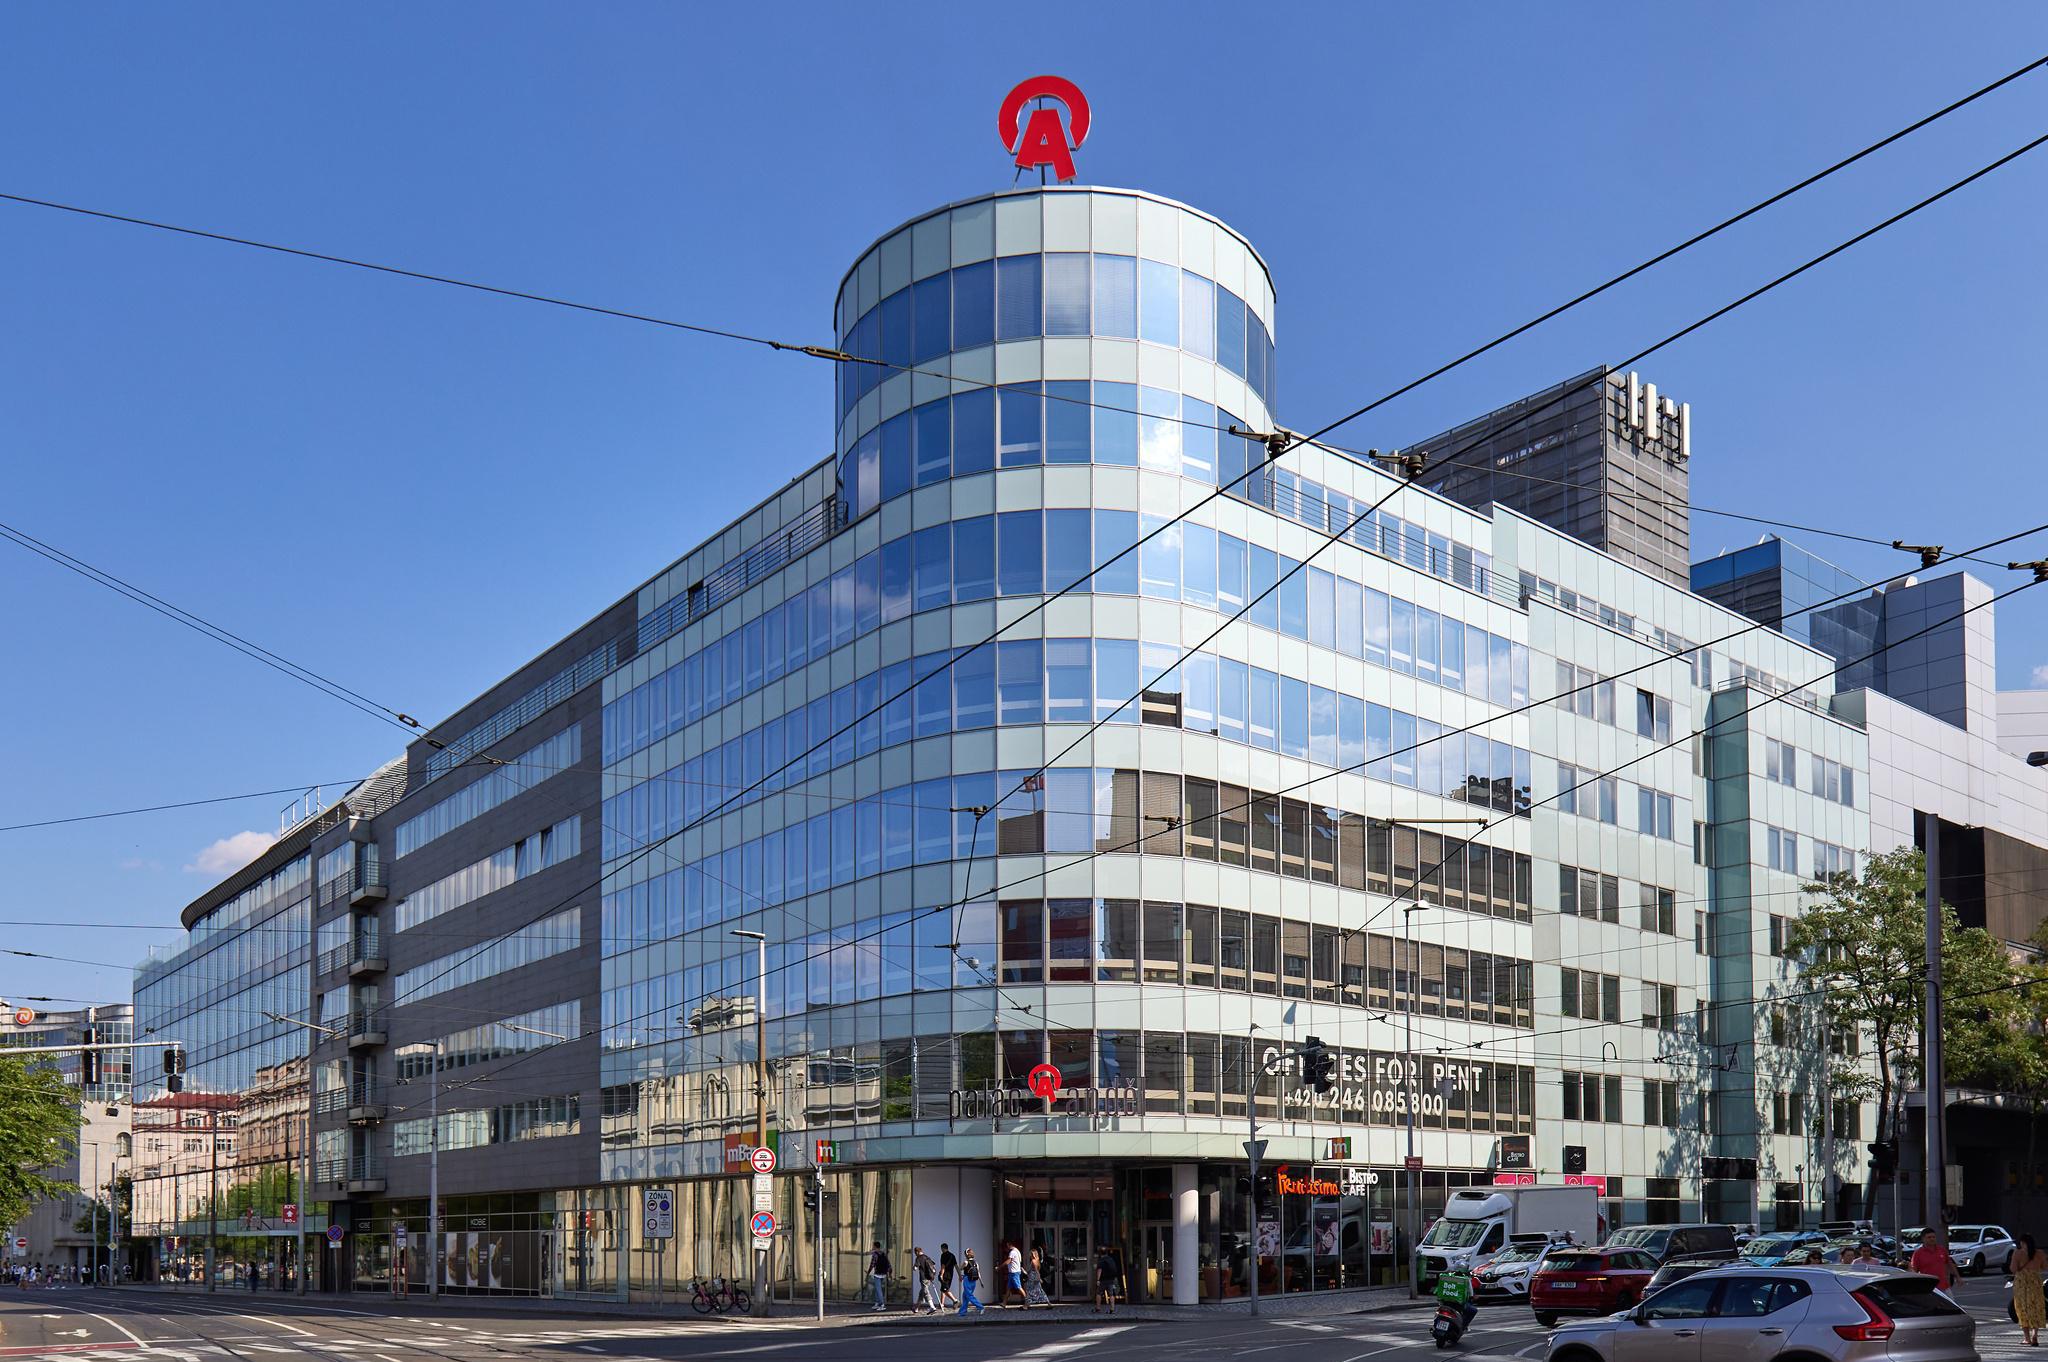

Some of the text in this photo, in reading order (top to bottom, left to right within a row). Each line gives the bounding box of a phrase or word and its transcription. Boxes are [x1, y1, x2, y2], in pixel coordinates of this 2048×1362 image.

[1375, 1057, 1417, 1087] FOR
[1433, 1063, 1483, 1092] RENT
[1329, 1086, 1365, 1110] 246
[1411, 1093, 1444, 1116] 800
[1442, 1289, 1459, 1297] Food
[1443, 1282, 1456, 1290] Bolt
